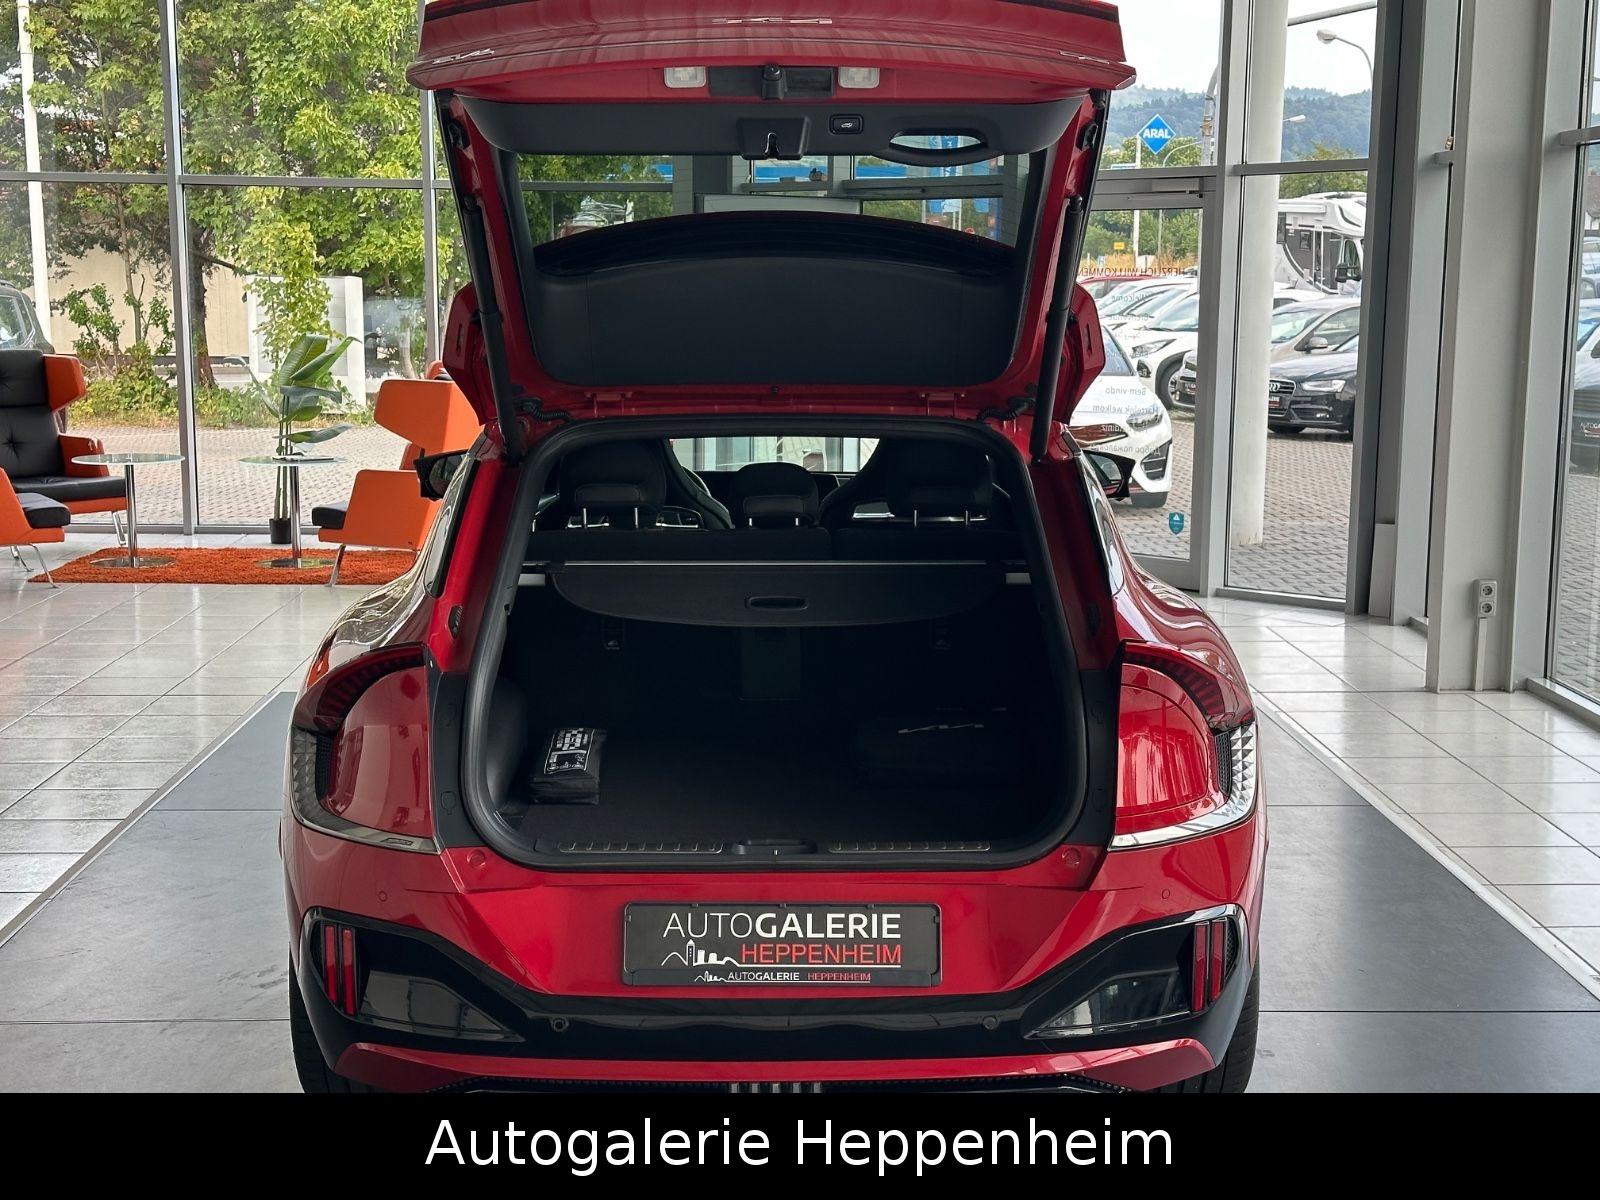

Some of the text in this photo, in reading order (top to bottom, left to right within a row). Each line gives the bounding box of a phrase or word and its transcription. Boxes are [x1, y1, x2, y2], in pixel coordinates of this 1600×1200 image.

[1142, 128, 1171, 139] ARAL
[663, 912, 901, 938] AUTOGALERIE
[742, 943, 902, 963] HEPPENHEIM
[728, 971, 871, 981] AUTOGALERIE HEPPENHEIM
